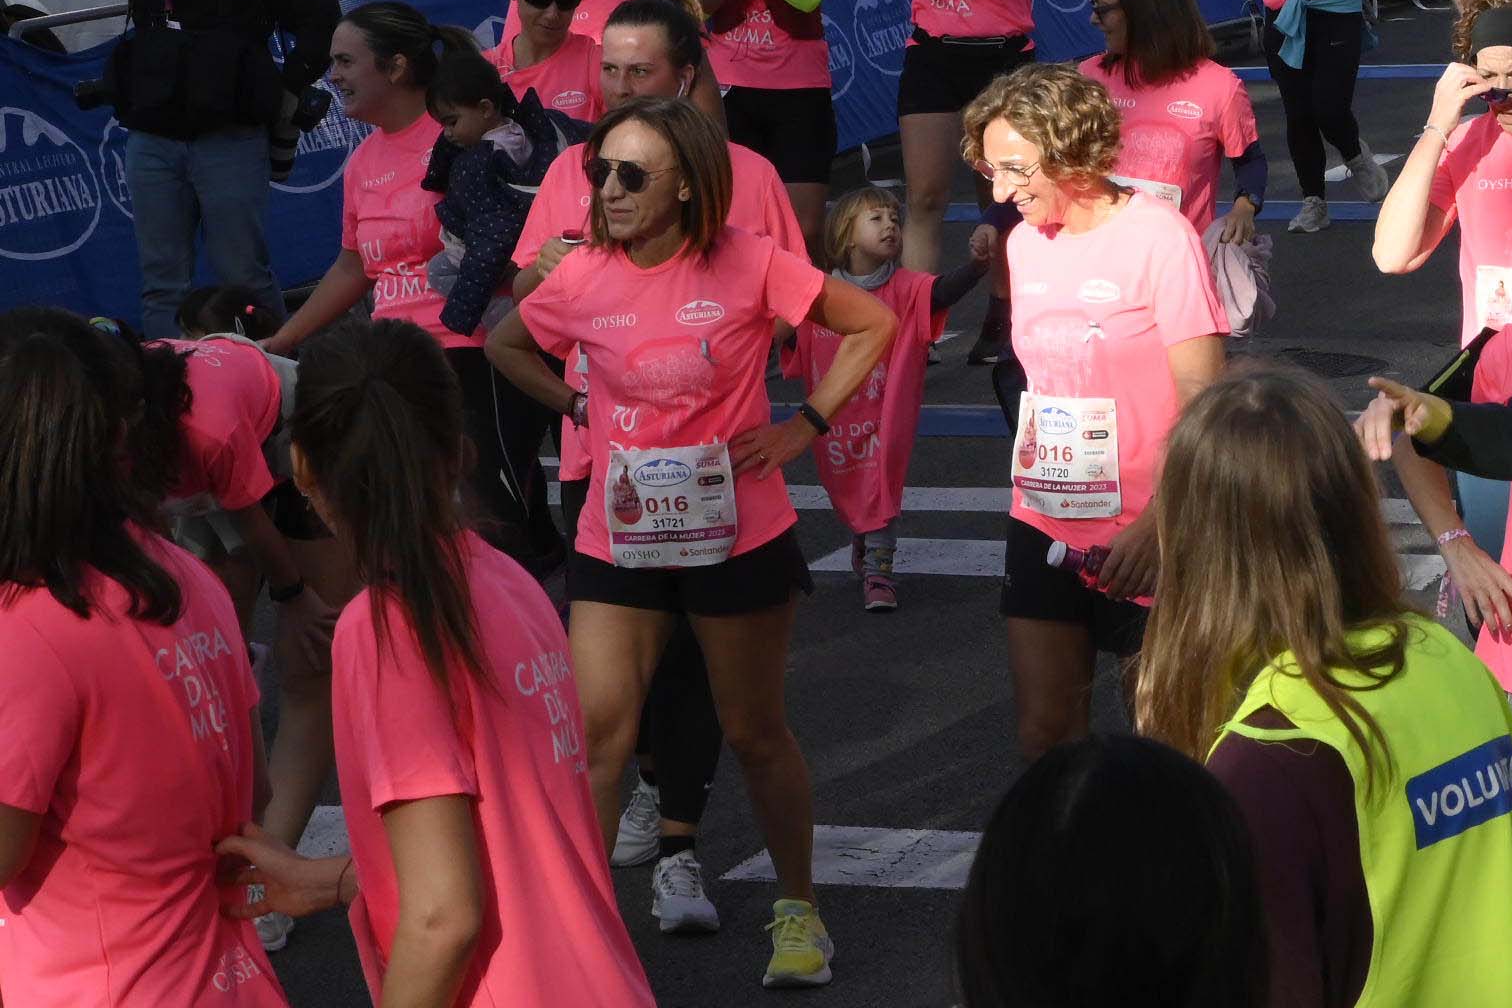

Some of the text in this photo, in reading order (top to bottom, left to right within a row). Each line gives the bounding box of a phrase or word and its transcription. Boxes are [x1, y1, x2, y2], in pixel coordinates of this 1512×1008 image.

[592, 313, 637, 330] OYSHO
[679, 309, 723, 323] ASTURIANA
[1038, 444, 1073, 462] 016
[695, 461, 721, 469] SUMA
[639, 470, 688, 482] ASTURIANA
[1040, 466, 1069, 478] 31720
[1020, 479, 1043, 489] CARRERA
[1052, 482, 1061, 490] LA
[1061, 483, 1087, 491] MUJER
[645, 495, 689, 513] 016
[1070, 499, 1112, 509] Santander
[652, 518, 685, 528] 31721
[624, 533, 657, 542] CARRERA
[658, 532, 668, 540] DE
[679, 531, 705, 540] MUJER
[708, 529, 726, 538] 2023
[623, 550, 660, 560] OYSHO
